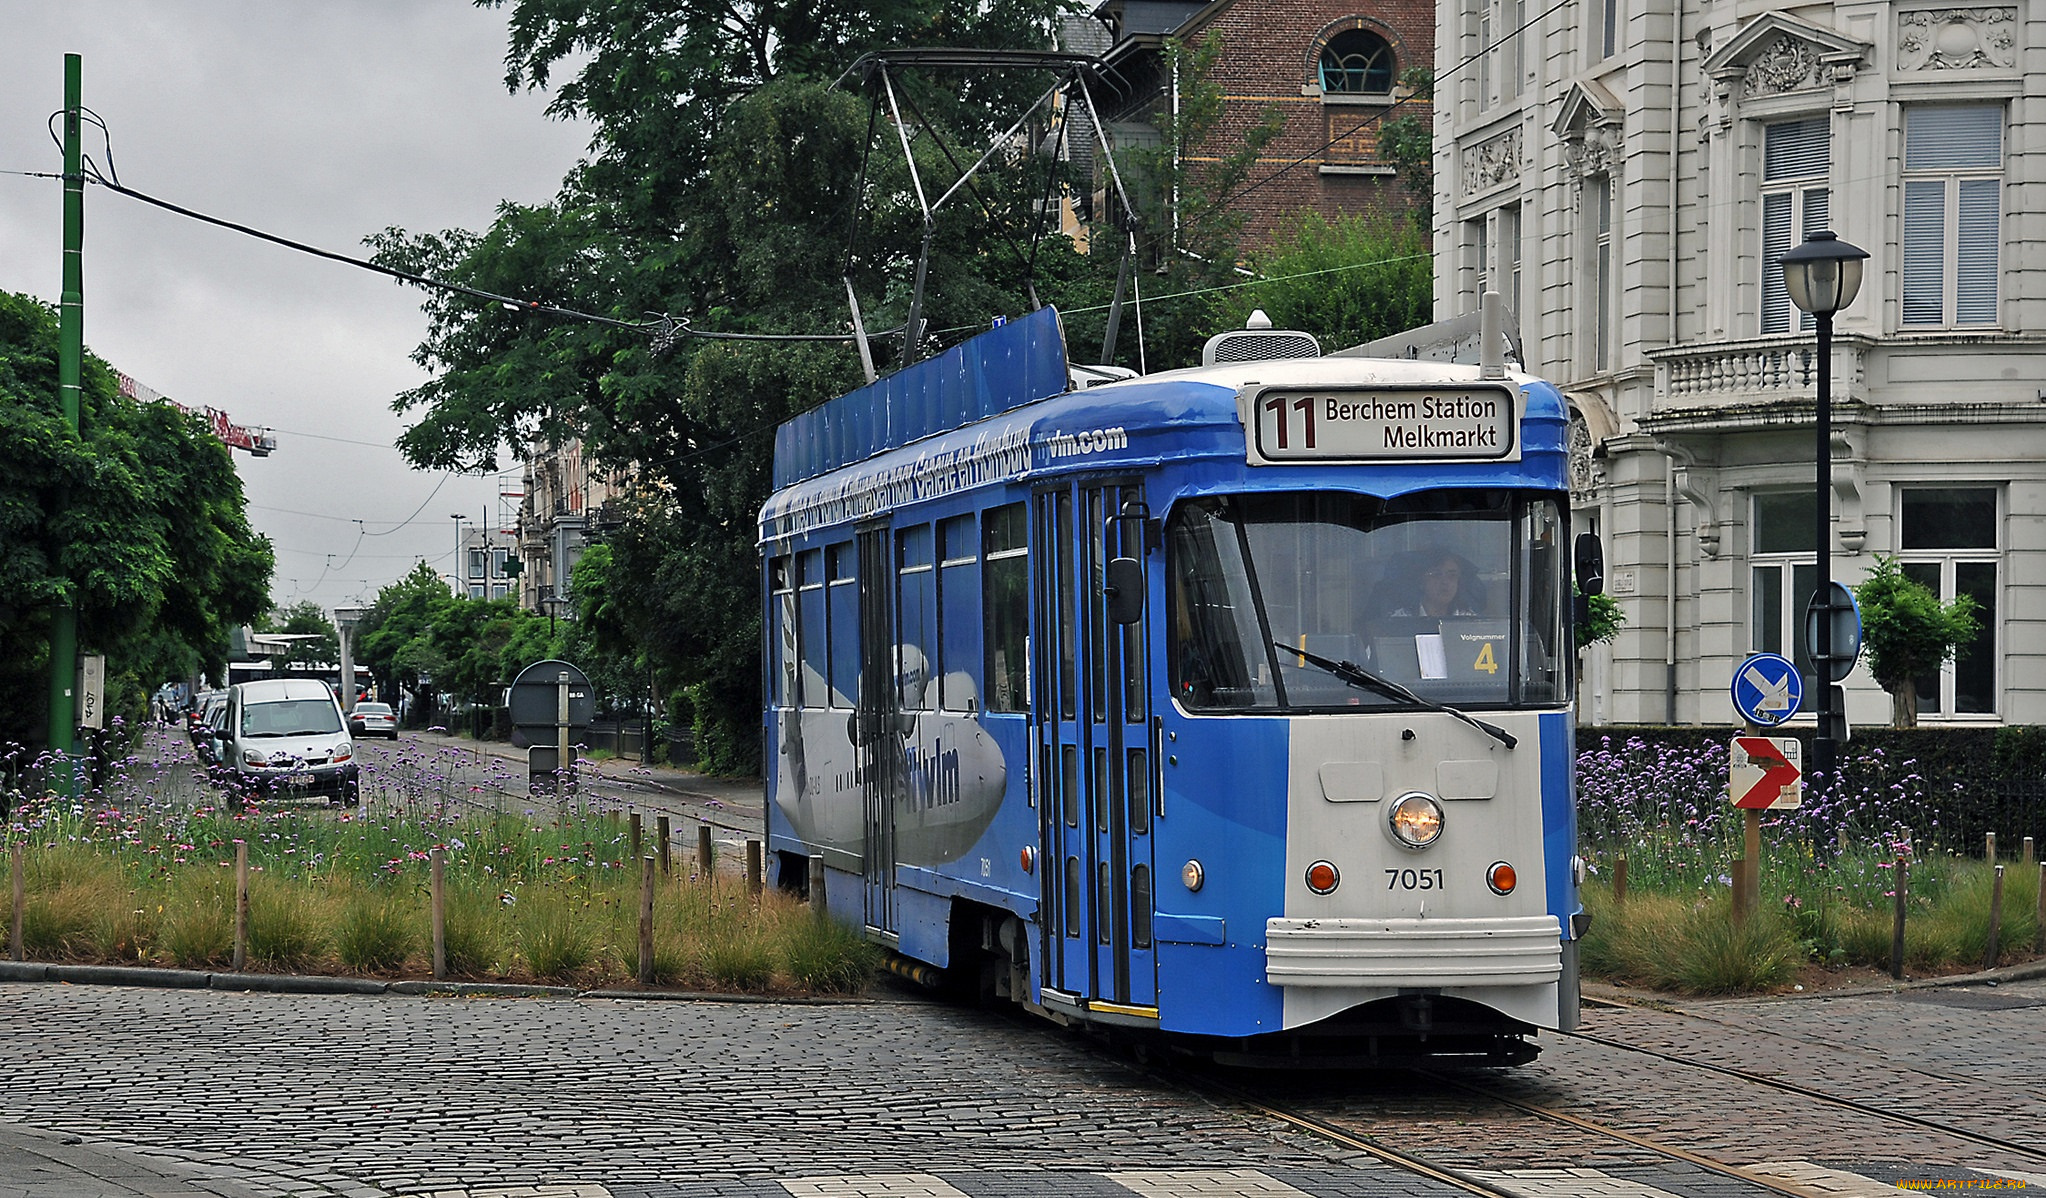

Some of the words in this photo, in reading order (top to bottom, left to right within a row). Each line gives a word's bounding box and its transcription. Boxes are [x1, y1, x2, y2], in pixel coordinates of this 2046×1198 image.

[1265, 397, 1316, 449] 11
[1326, 398, 1416, 421] Berchem
[1422, 396, 1496, 419] Station
[1384, 425, 1497, 448] Melkmarkt
[1460, 634, 1506, 642] Volgnummer
[1474, 642, 1499, 674] 4
[1385, 868, 1444, 890] 7051
